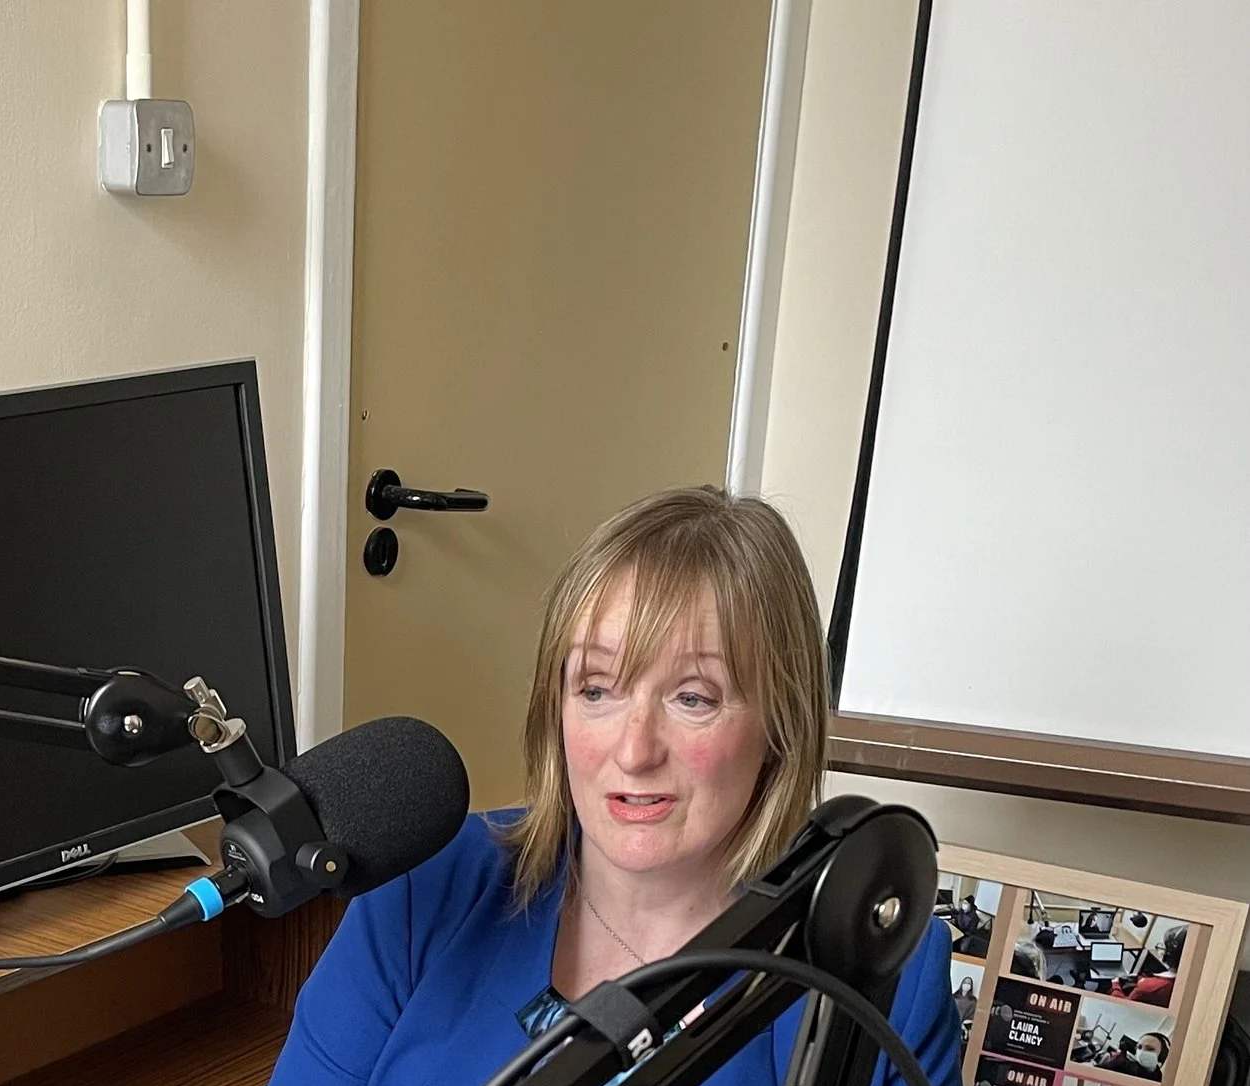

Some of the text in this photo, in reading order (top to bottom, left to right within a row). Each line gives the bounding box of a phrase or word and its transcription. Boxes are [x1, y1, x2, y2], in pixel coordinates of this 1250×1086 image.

[60, 843, 92, 863] DELL
[1029, 993, 1072, 1013] ON AIR
[1010, 1019, 1039, 1035] LAURA
[1008, 1029, 1043, 1046] CLANCY
[1007, 1069, 1024, 1084] ON
